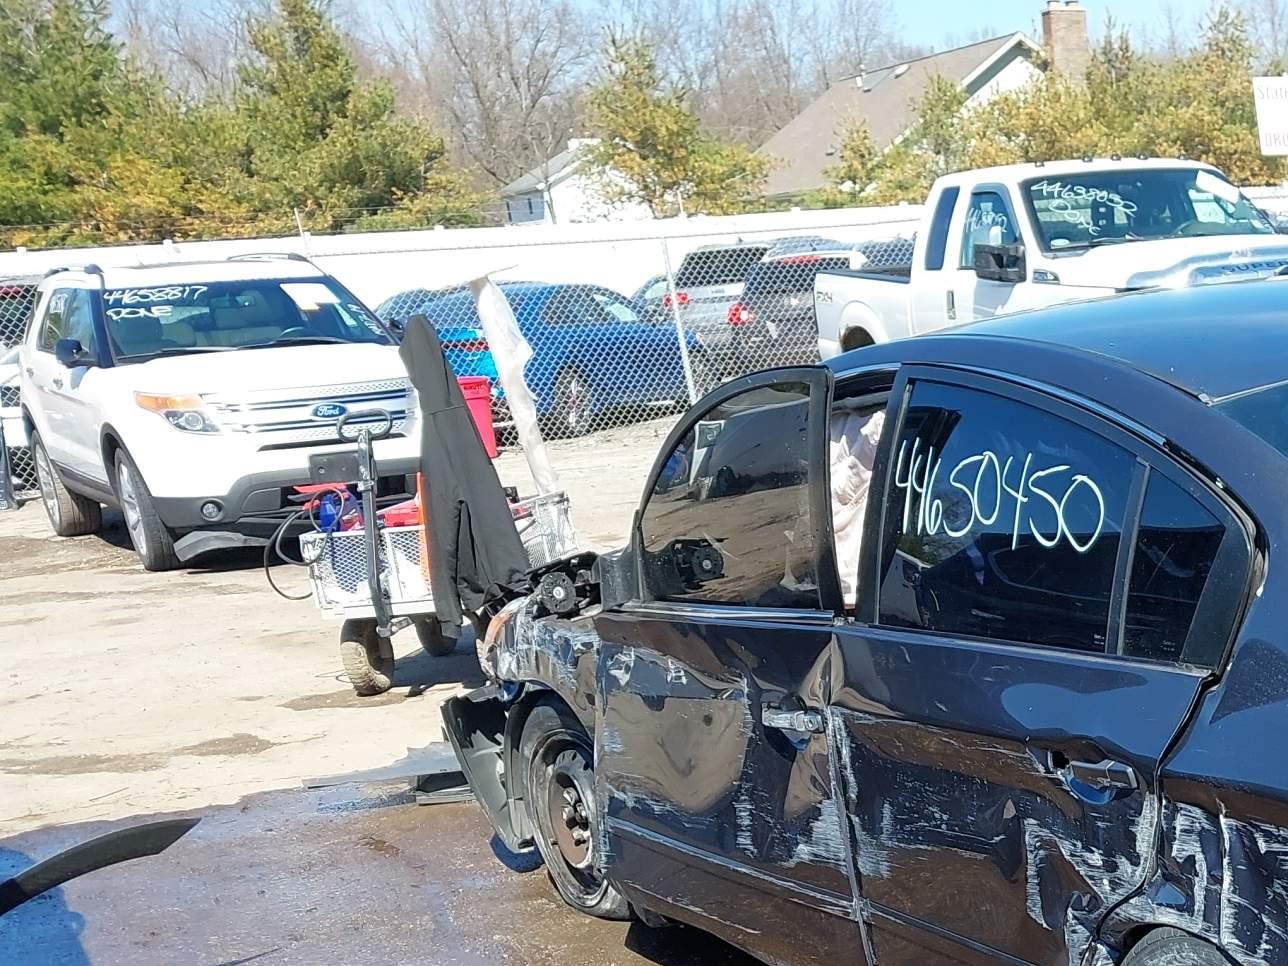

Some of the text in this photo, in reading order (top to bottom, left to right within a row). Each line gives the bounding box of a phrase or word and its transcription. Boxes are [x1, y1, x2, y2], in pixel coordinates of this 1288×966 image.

[103, 285, 209, 305] 44658817
[106, 305, 174, 321] DONE
[895, 436, 1105, 552] 44650450
